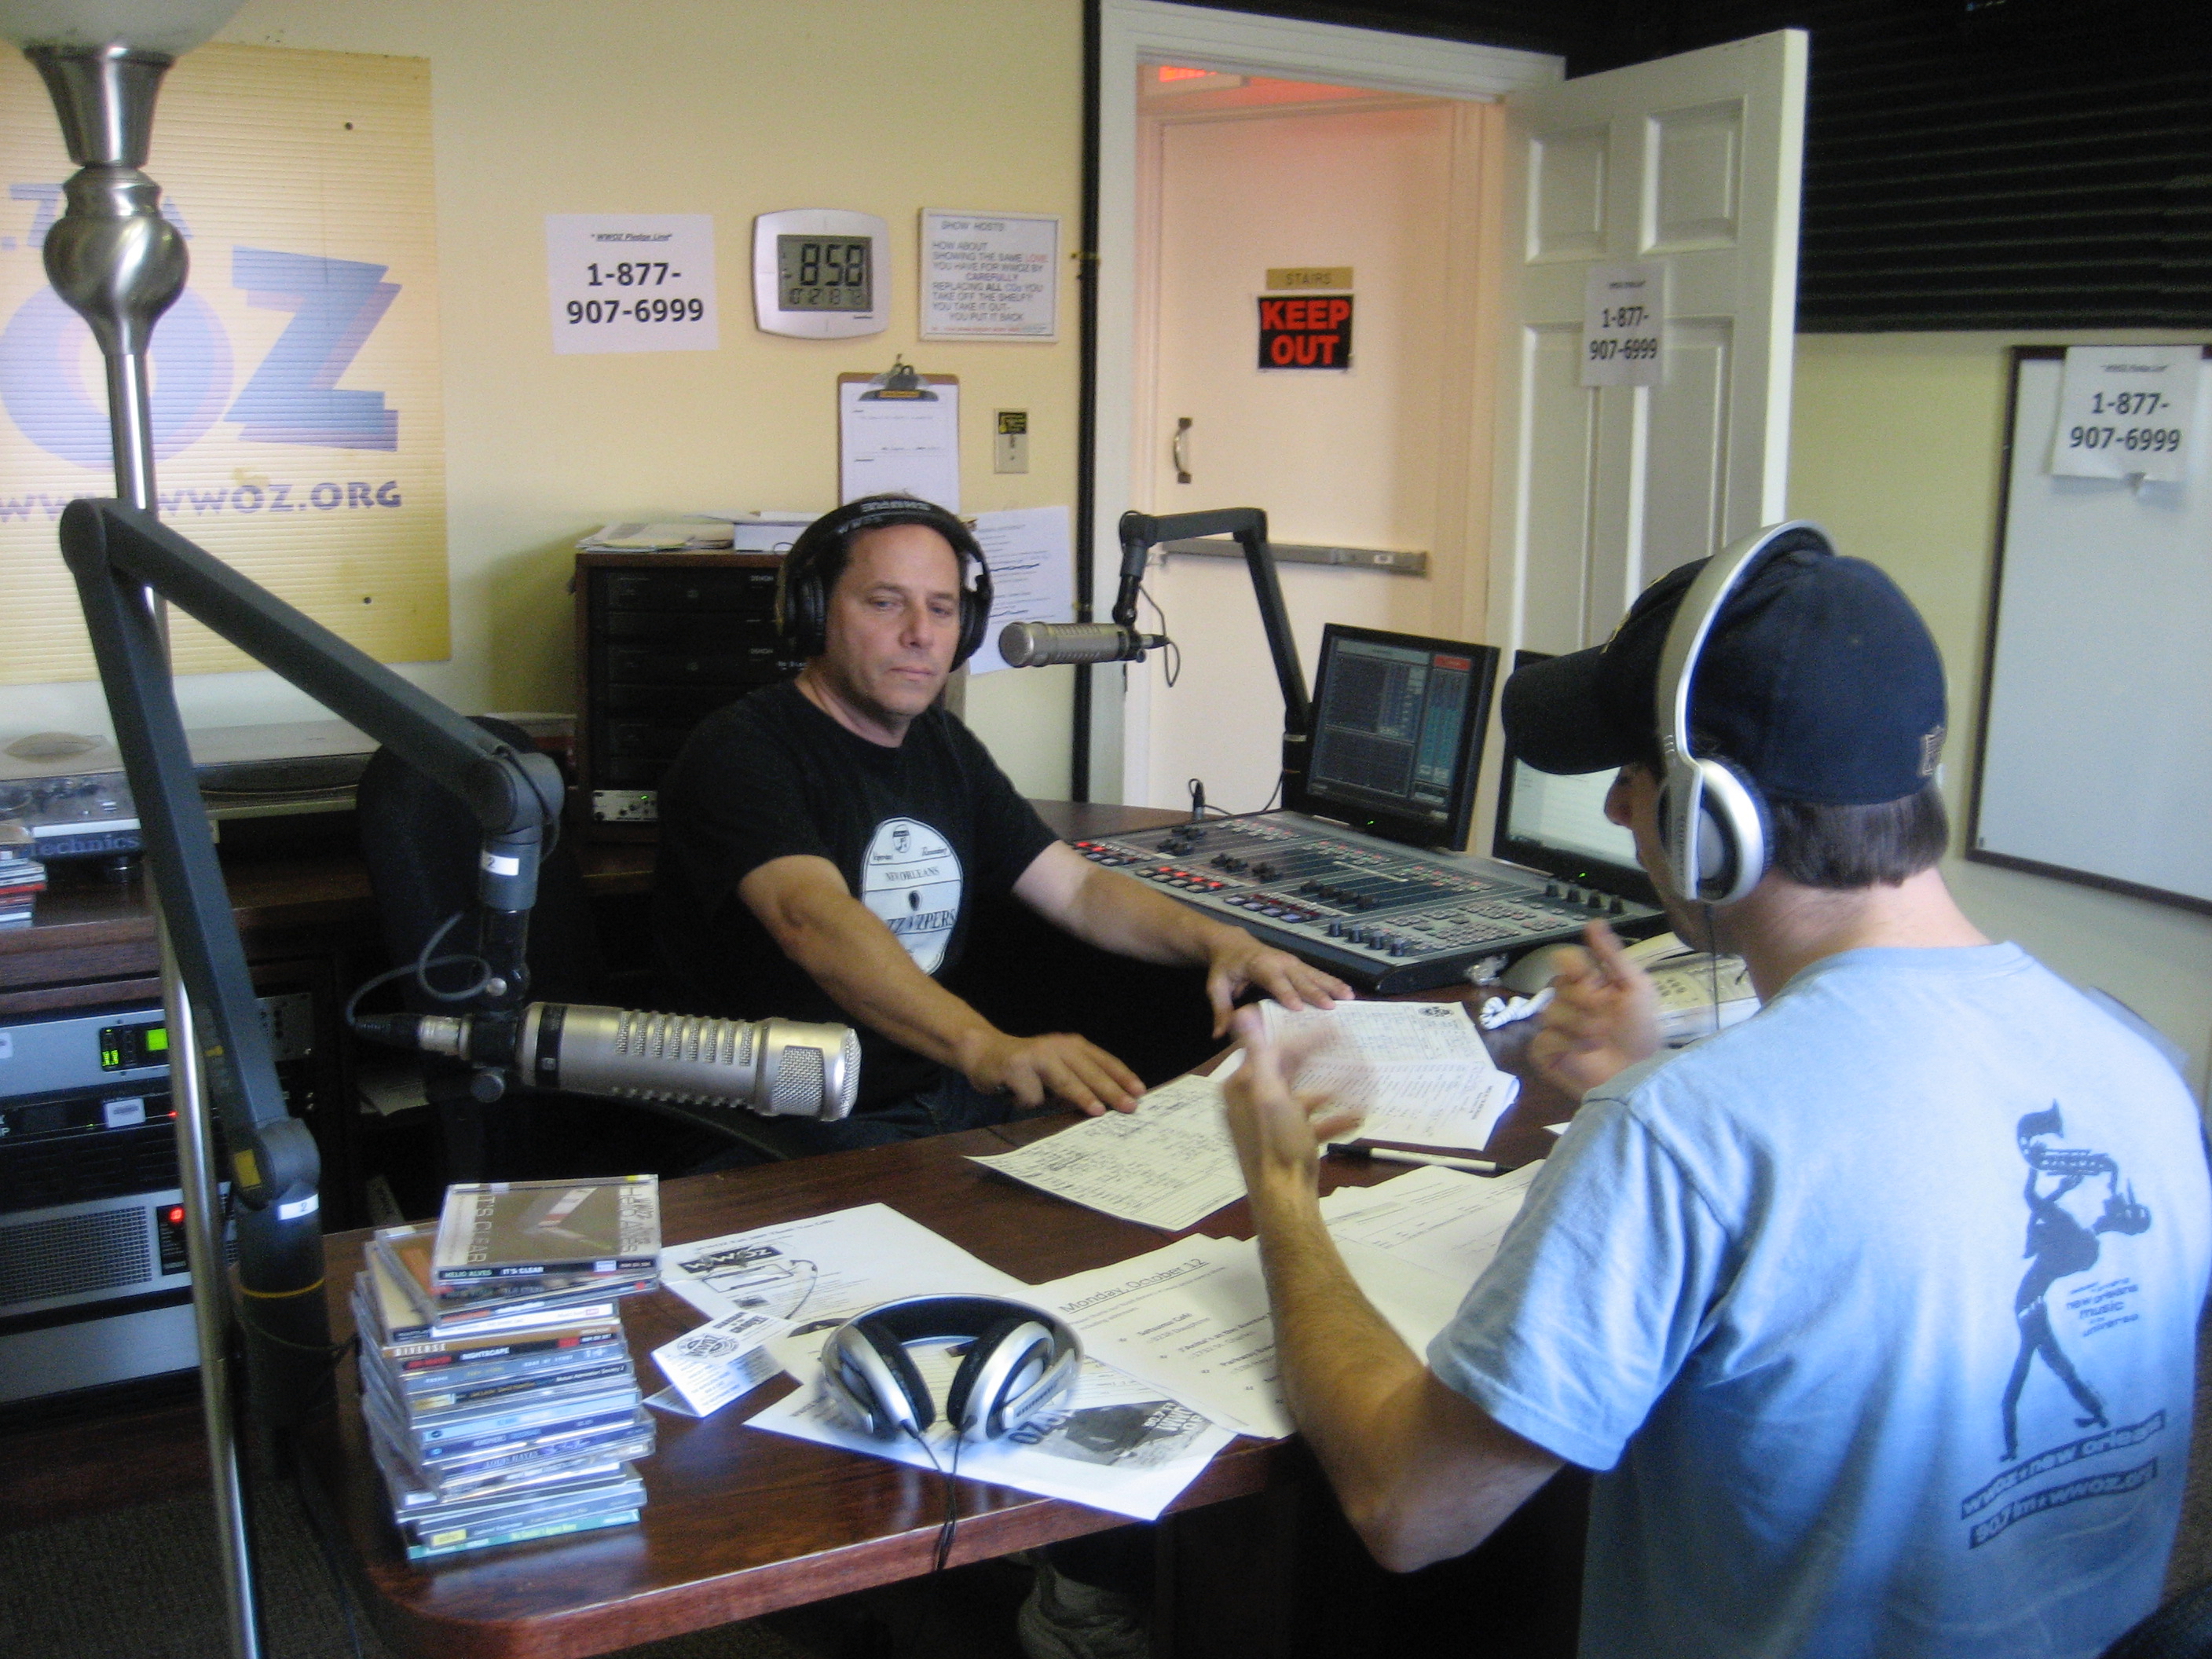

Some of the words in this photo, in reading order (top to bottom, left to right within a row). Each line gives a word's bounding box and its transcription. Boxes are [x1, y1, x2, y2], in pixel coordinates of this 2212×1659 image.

[588, 262, 681, 286] 1-877-
[1286, 273, 1331, 284] STAIRS
[986, 283, 1002, 291] ALL
[567, 298, 704, 324] 907-6999
[1261, 299, 1350, 330] KEEP
[1602, 306, 1649, 328] 1-877-
[1271, 335, 1340, 365] OUT
[1590, 338, 1657, 360] 907-6999
[2092, 392, 2170, 415] 1-877-
[2070, 426, 2181, 452] 907-6999
[902, 866, 940, 881] ORLEANS
[1126, 1265, 1183, 1289] October
[1183, 1258, 1205, 1269] 12
[395, 1343, 446, 1357] DIVERSE
